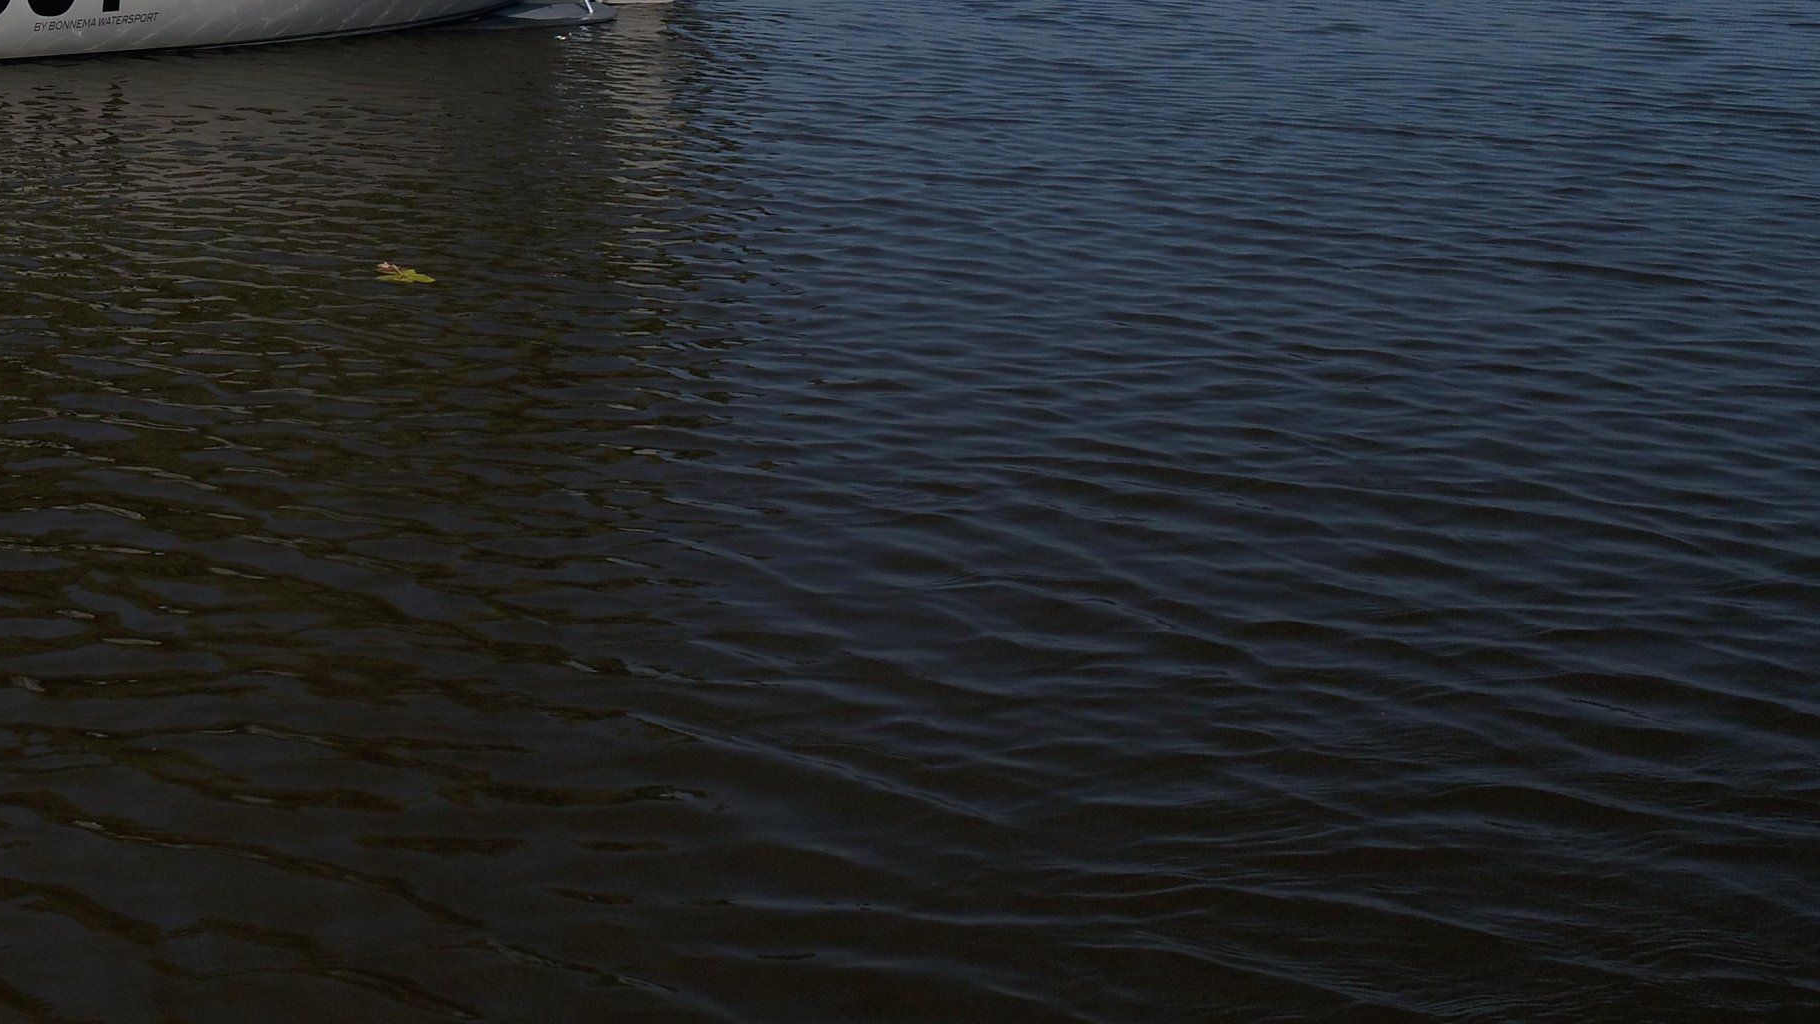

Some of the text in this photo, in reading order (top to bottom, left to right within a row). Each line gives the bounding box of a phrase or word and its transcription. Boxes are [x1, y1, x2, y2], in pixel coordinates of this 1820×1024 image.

[34, 12, 159, 32] BY BONNEMA WATERSPORT
